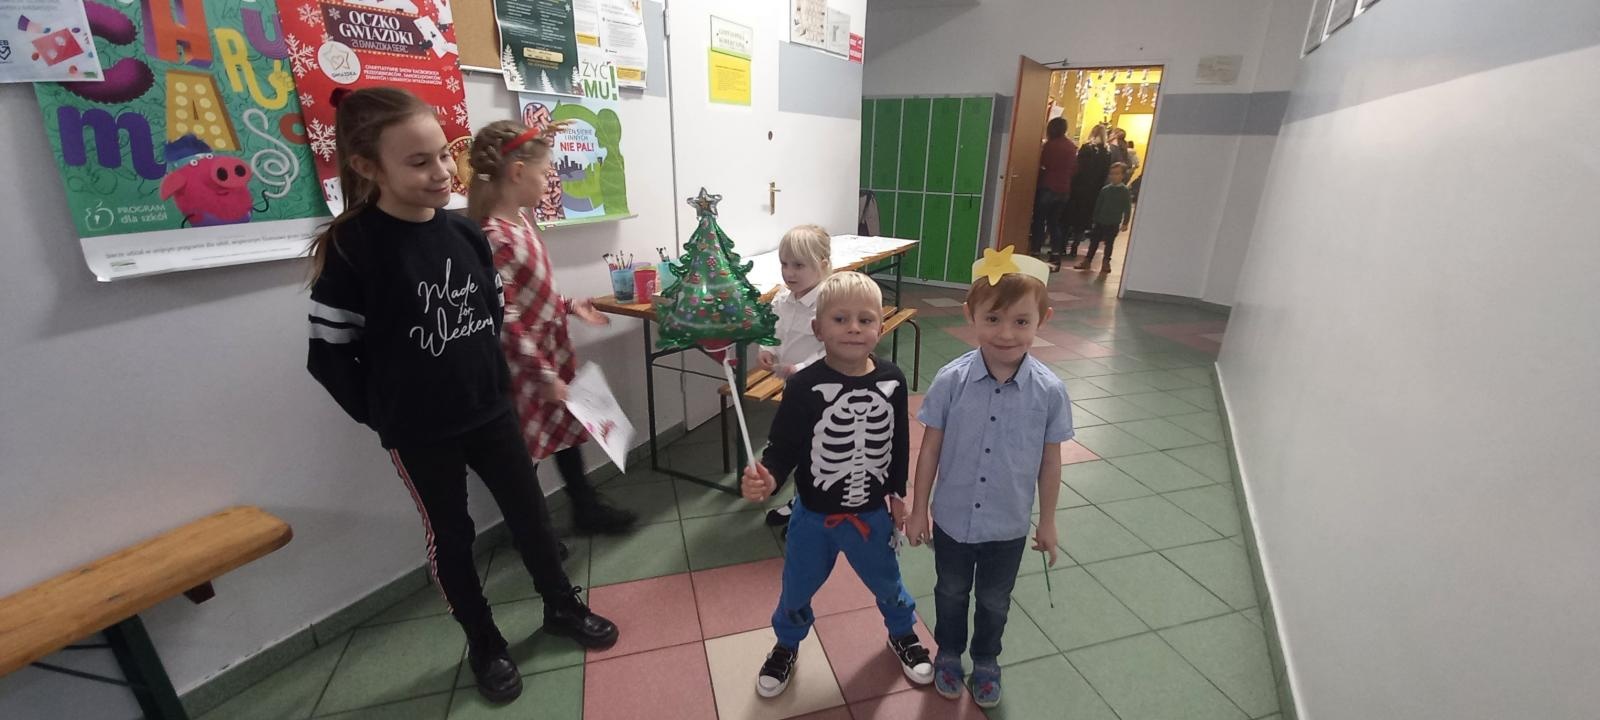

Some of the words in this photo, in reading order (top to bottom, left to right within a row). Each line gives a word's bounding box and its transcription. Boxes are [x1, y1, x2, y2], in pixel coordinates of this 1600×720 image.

[349, 10, 400, 31] OCZKO
[339, 22, 414, 46] GWIAZDKI
[581, 60, 609, 80] ŻYĆ
[583, 66, 618, 100] MU!
[560, 142, 576, 152] NIE
[576, 142, 595, 152] PAL!
[117, 204, 166, 213] PROGRAM
[121, 214, 138, 223] dla
[142, 212, 168, 222] szkół
[418, 258, 478, 314] Made
[457, 303, 476, 324] for
